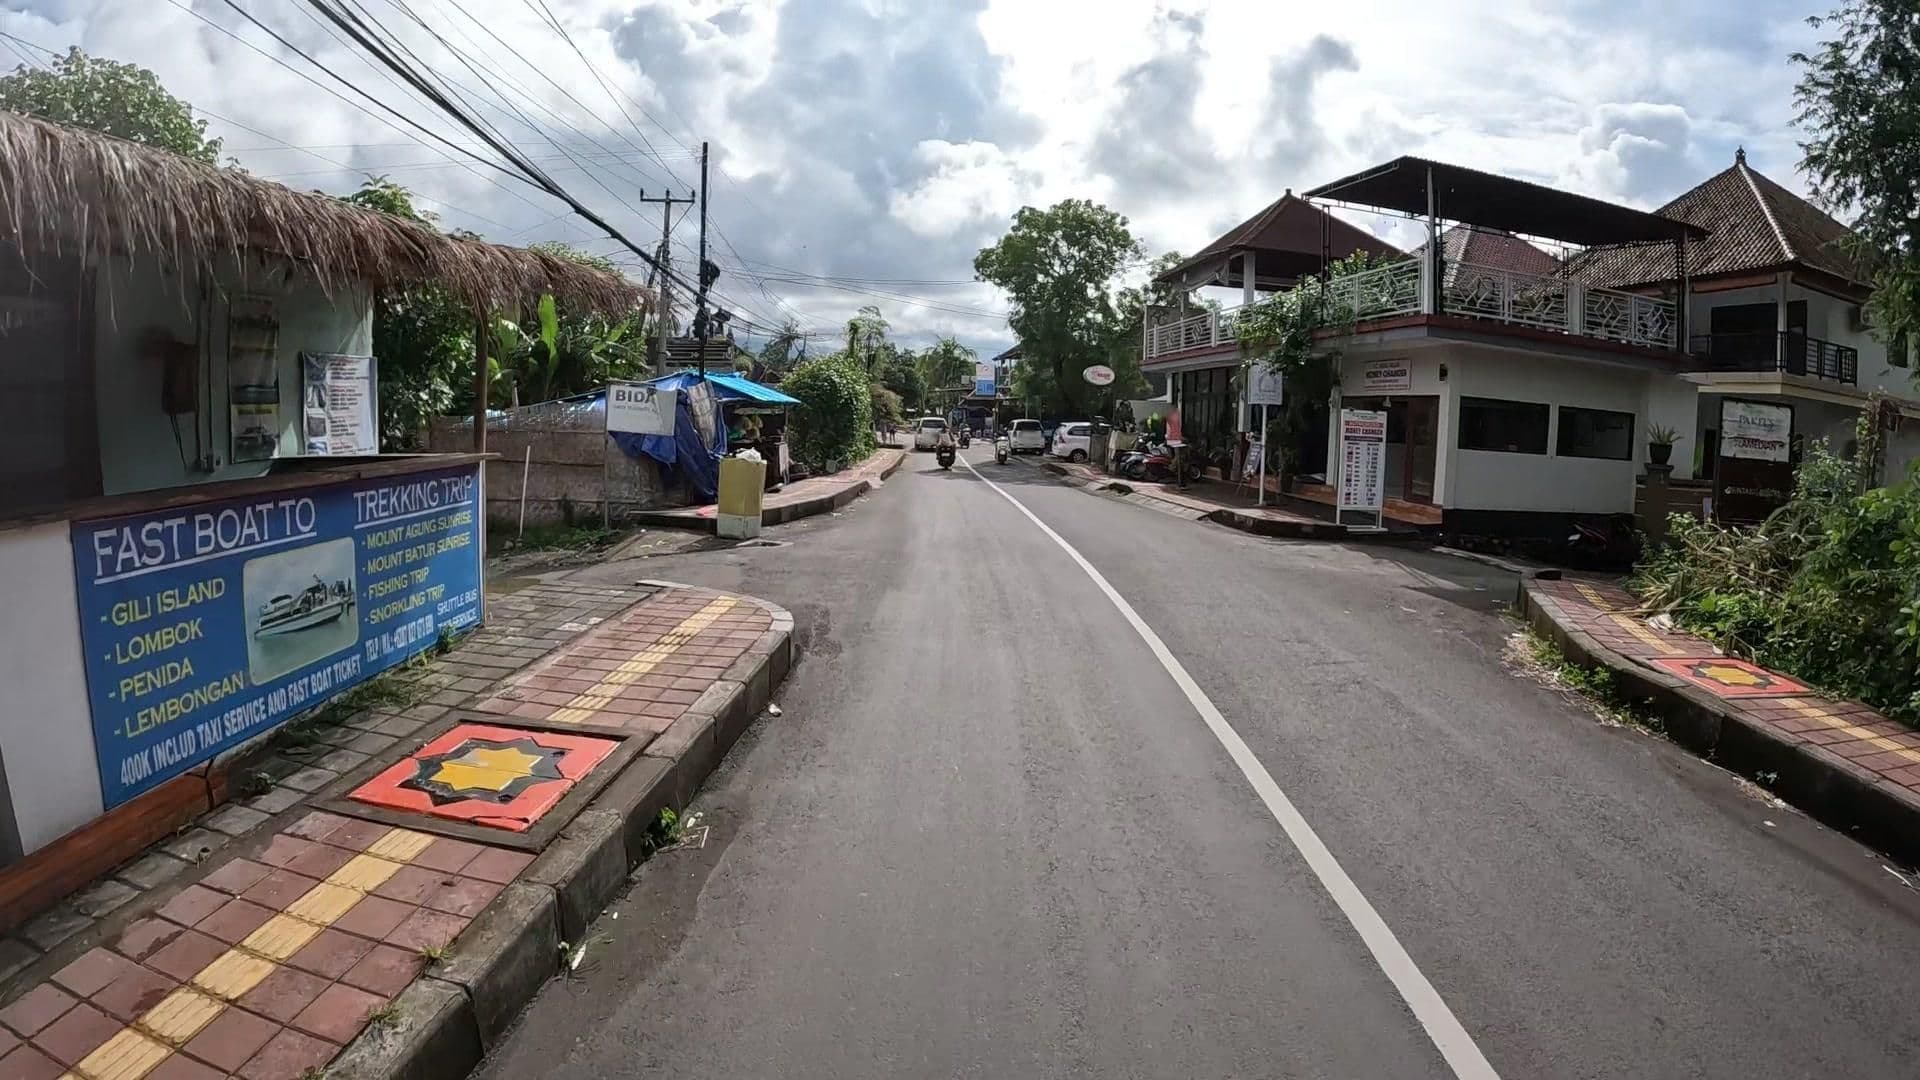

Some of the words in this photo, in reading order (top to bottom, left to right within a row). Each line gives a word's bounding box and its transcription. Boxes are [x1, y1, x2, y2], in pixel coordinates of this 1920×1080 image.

[353, 481, 439, 522] TREKKING
[440, 475, 473, 504] TRIP
[93, 517, 187, 577] FAST
[194, 503, 274, 555] BOAT
[279, 498, 316, 536] TO
[367, 527, 404, 549] MOUNT
[405, 519, 437, 539] AGUNG
[437, 510, 473, 530] SUNRISE
[367, 551, 404, 574] MOUNT
[405, 542, 436, 563] BATUR
[437, 532, 471, 554] SUNRISE
[111, 596, 152, 626] GILI
[157, 577, 225, 614] ISLAND
[368, 574, 408, 600] FISHING
[409, 567, 430, 585] TRIP
[369, 591, 426, 624] SNORKLING
[426, 583, 445, 601] TRIP
[437, 593, 464, 615] SHUTTLE
[115, 618, 203, 664] LOMBOK
[119, 657, 195, 703] PENIDA
[121, 750, 152, 787] 400K
[153, 729, 196, 771] INCLUD
[197, 717, 223, 751] TAXI
[223, 697, 267, 737] SERVICE
[267, 688, 287, 716] AND
[287, 678, 310, 707] FAST
[310, 665, 333, 695] BOAT
[333, 653, 361, 684] TICKET
[125, 671, 245, 738] LEMBONGAN
